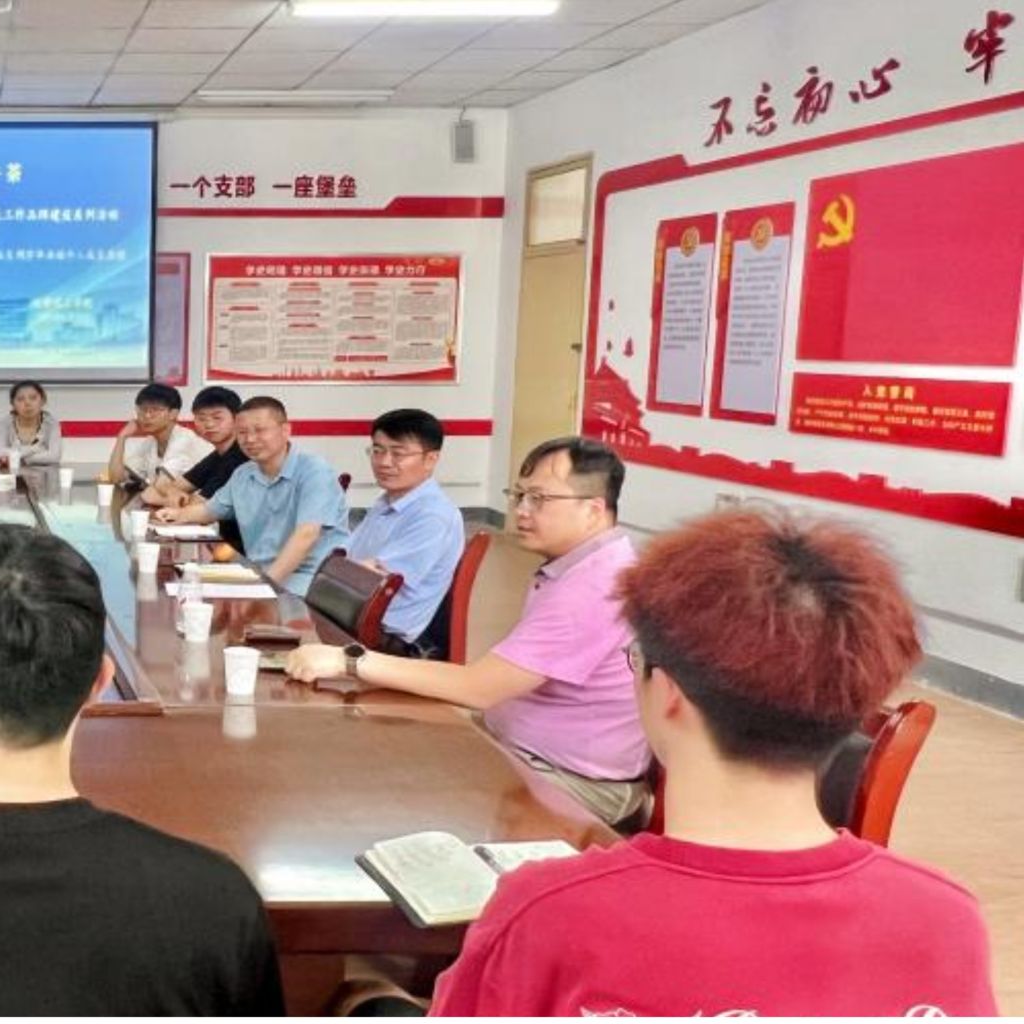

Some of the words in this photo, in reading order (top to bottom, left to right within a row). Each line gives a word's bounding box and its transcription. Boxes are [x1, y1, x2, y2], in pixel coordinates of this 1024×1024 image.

[705, 59, 901, 147] 不忘初心
[170, 175, 256, 198] 一个支部
[272, 175, 357, 198] 一座堡垒
